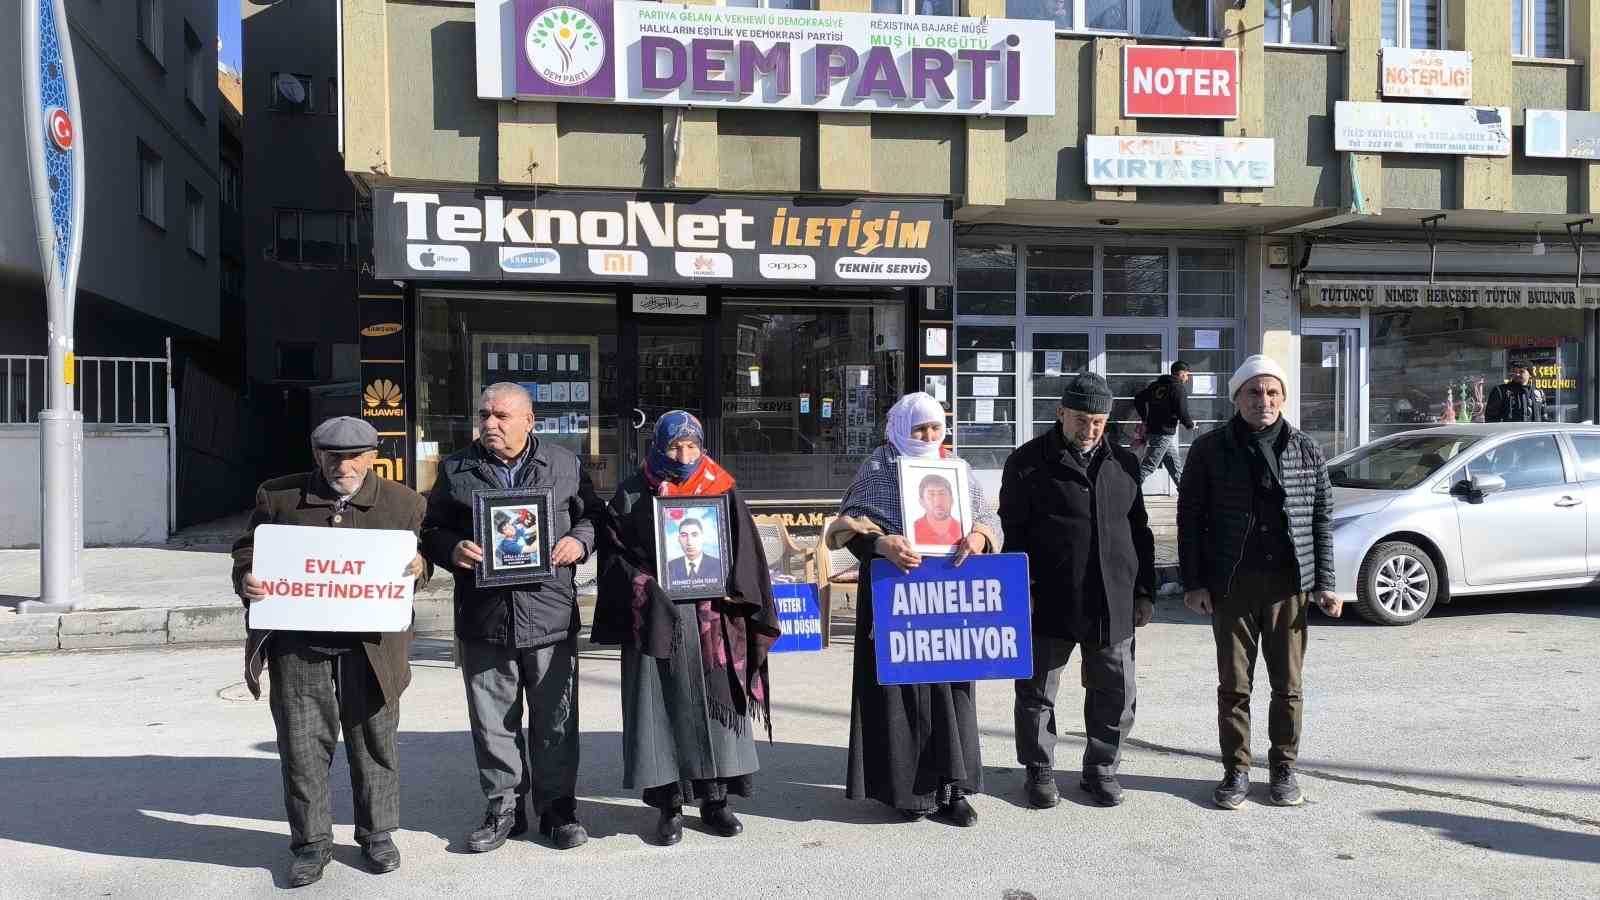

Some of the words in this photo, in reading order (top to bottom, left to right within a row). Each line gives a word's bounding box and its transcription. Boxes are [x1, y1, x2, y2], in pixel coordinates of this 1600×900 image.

[640, 24, 696, 35] HALKLARIN
[736, 29, 749, 38] VE
[750, 29, 804, 40] DEMOKRASİ
[870, 35, 902, 48] MUŞ
[641, 36, 791, 95] DEM
[816, 34, 1020, 101] PARTİ
[1133, 67, 1231, 96] NOTER
[393, 192, 756, 250] TeknoNet
[771, 207, 931, 256] İLETİŞİM
[839, 262, 883, 273] TEKNİK
[886, 262, 928, 274] SERVİS
[363, 409, 404, 417] HUAWEI
[305, 559, 366, 575] EVLAT
[262, 579, 405, 599] NÖBETİNDEYİZ
[892, 579, 1003, 616] ANNELER
[778, 598, 801, 613] YETER
[889, 619, 1018, 663] DİRENİYOR
